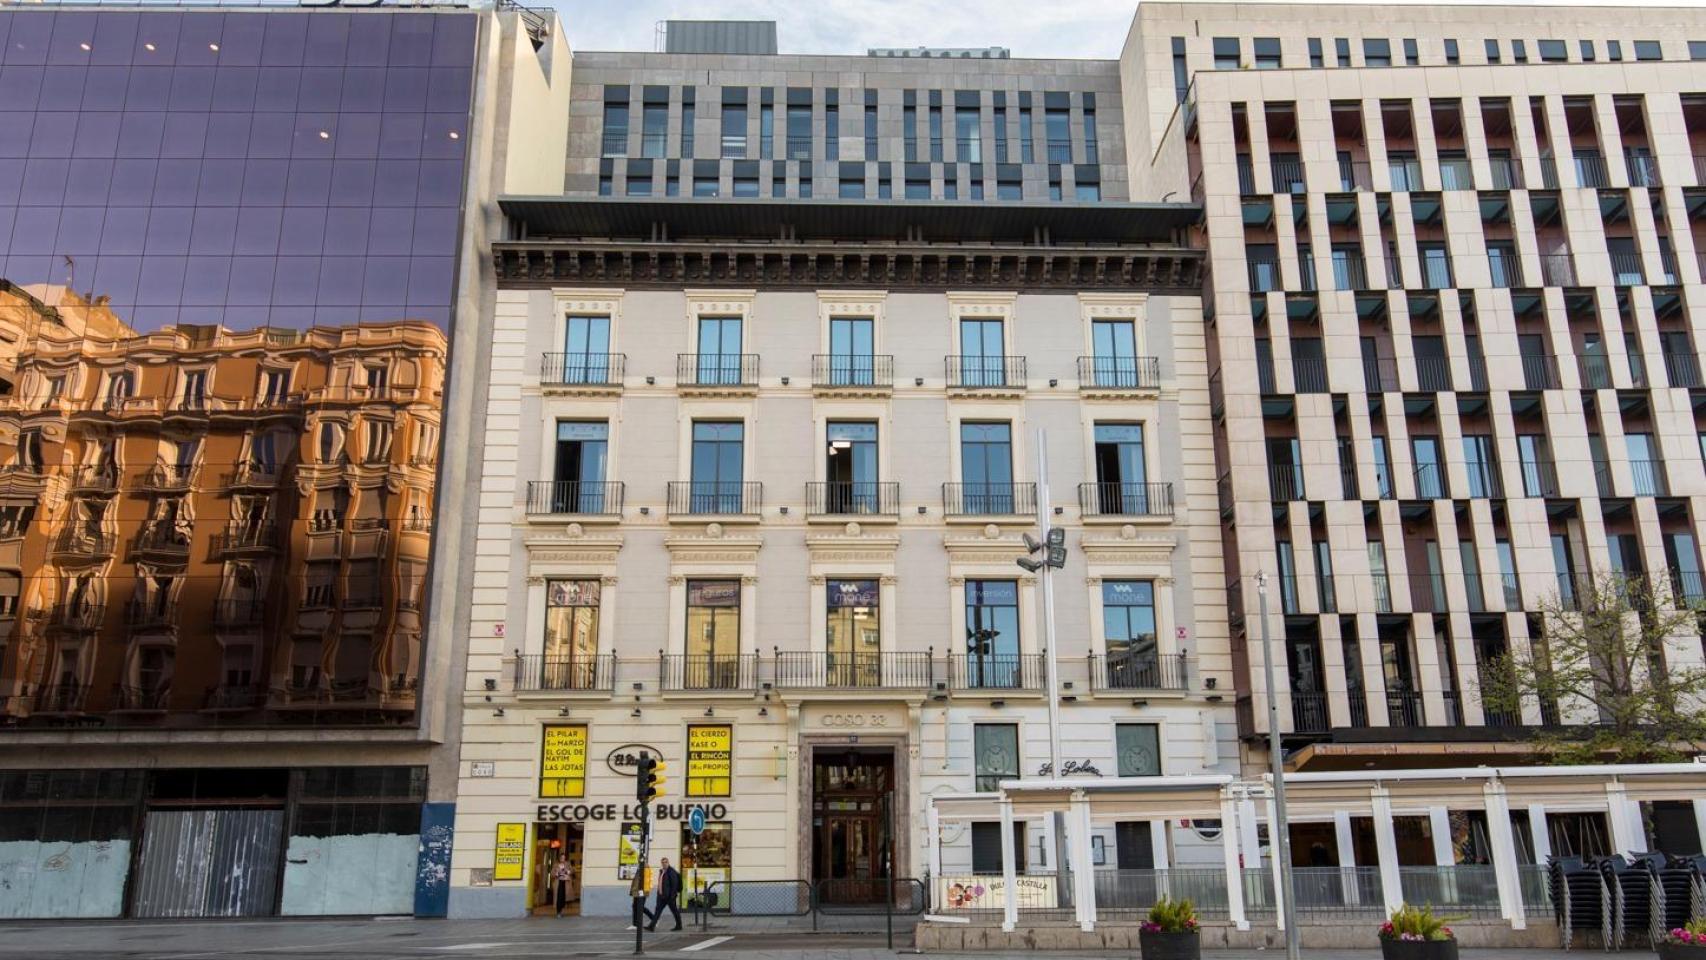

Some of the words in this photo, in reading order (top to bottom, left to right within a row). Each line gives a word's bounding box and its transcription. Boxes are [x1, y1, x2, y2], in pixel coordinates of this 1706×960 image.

[821, 714, 865, 727] COSO
[537, 804, 616, 821] ESCOGE
[623, 804, 645, 820] LO
[656, 803, 727, 820] BUENO
